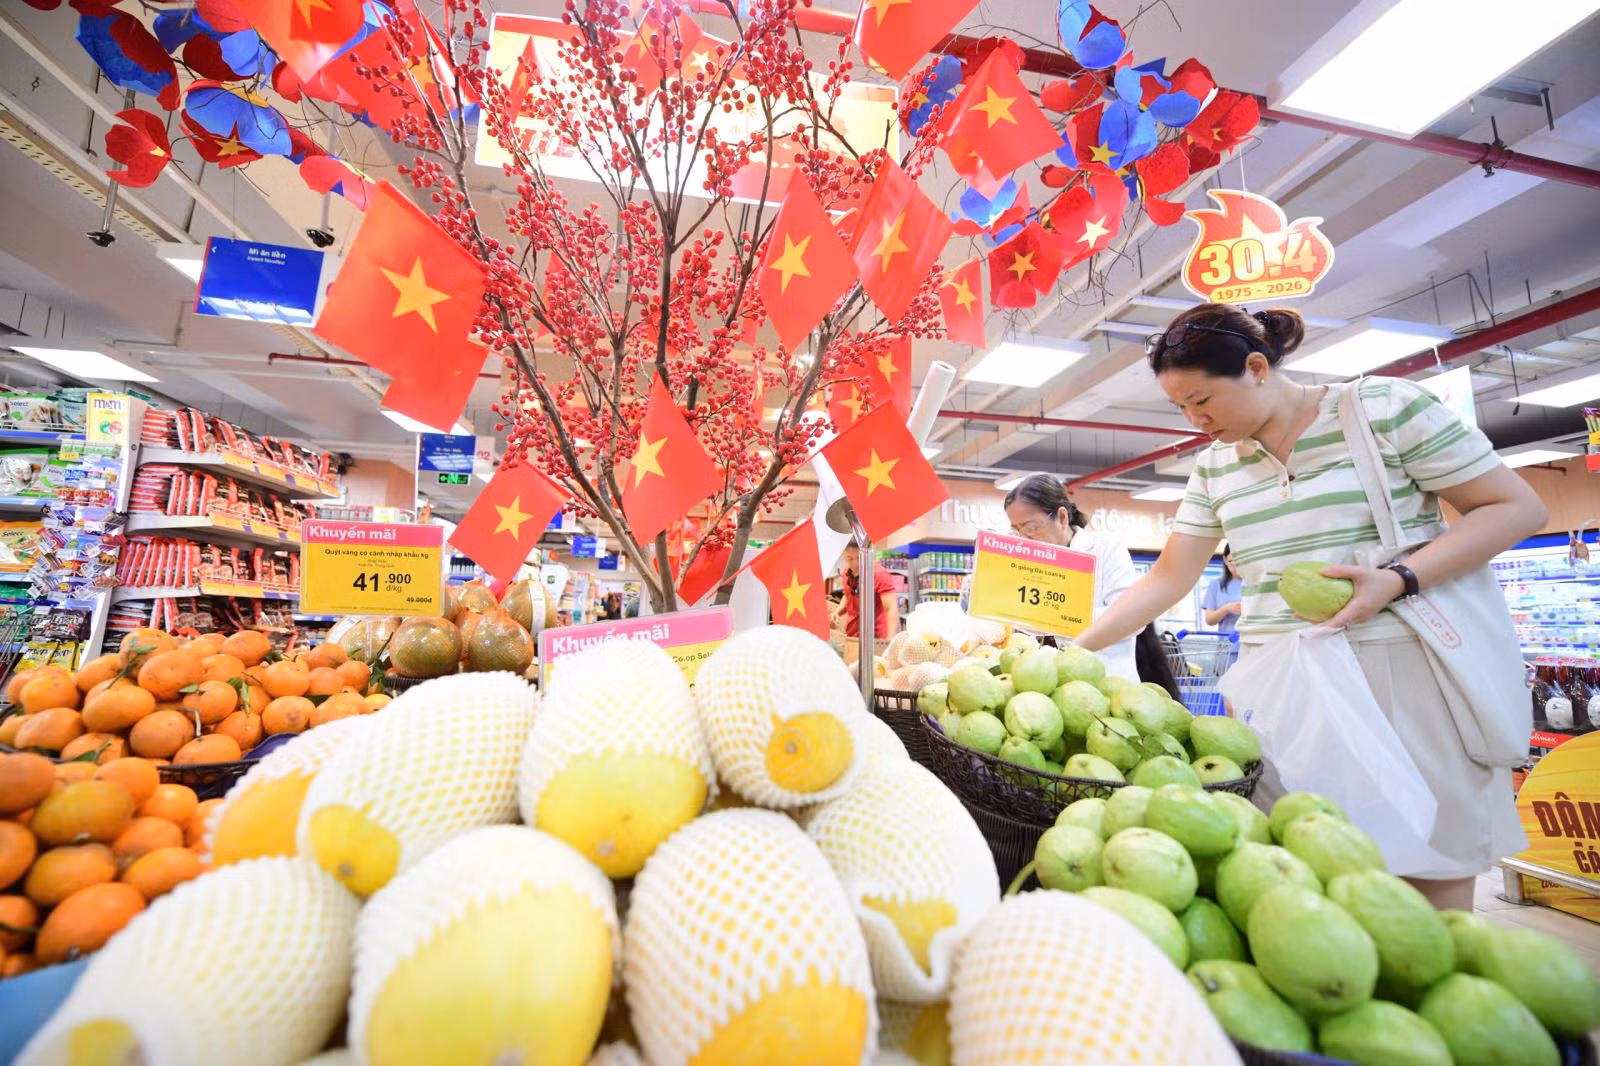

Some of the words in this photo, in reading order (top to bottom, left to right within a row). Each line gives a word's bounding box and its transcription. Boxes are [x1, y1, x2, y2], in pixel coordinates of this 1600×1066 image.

[1199, 232, 1318, 286] 30.4
[1217, 286, 1251, 300] 1975
[1267, 280, 1303, 294] 2026
[309, 525, 366, 541] Khuyến
[369, 528, 397, 540] mãi
[420, 552, 429, 560] kg
[982, 535, 1031, 555] Khuyến
[1033, 548, 1057, 561] mãi
[352, 572, 379, 592] 41
[1017, 585, 1041, 605] 13
